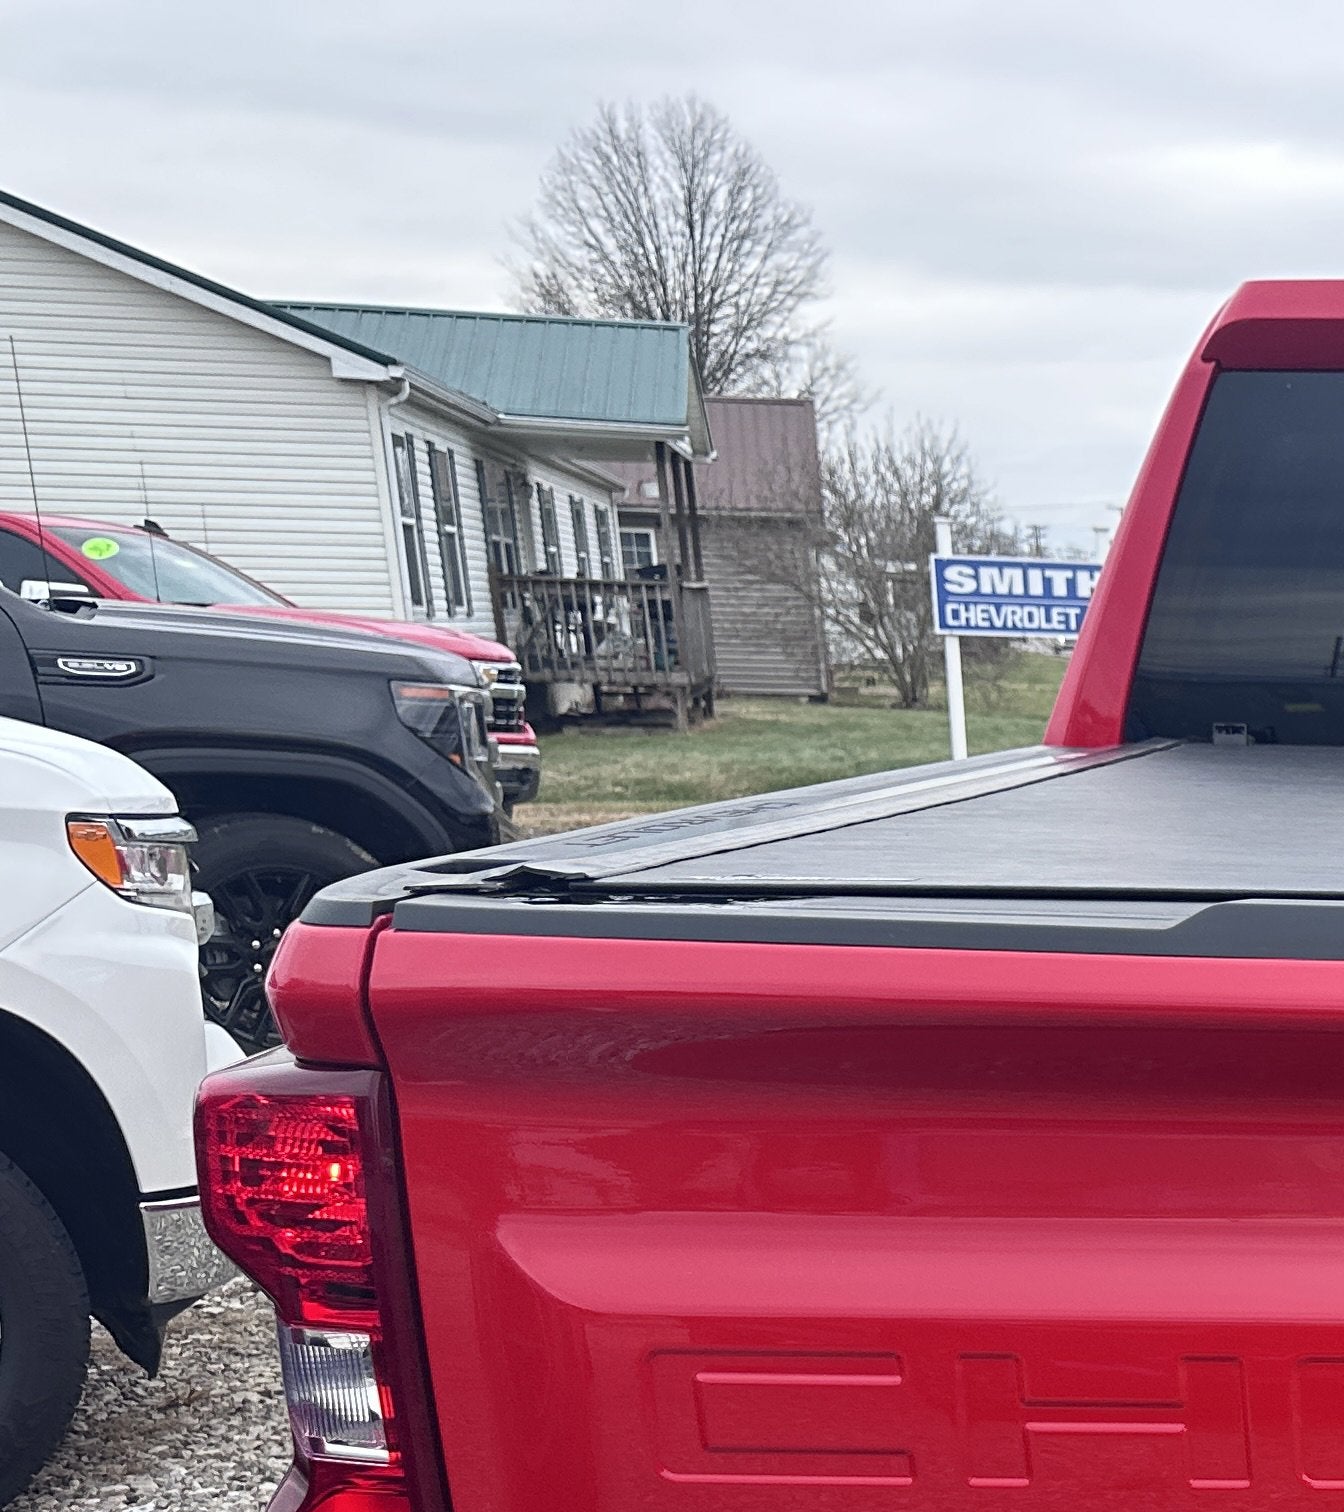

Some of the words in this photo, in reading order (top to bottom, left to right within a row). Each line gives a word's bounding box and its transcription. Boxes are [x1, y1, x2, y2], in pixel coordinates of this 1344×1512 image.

[943, 564, 1101, 598] SMITH
[945, 602, 1081, 631] CHEVROLET
[564, 801, 800, 848] CHEVROLET
